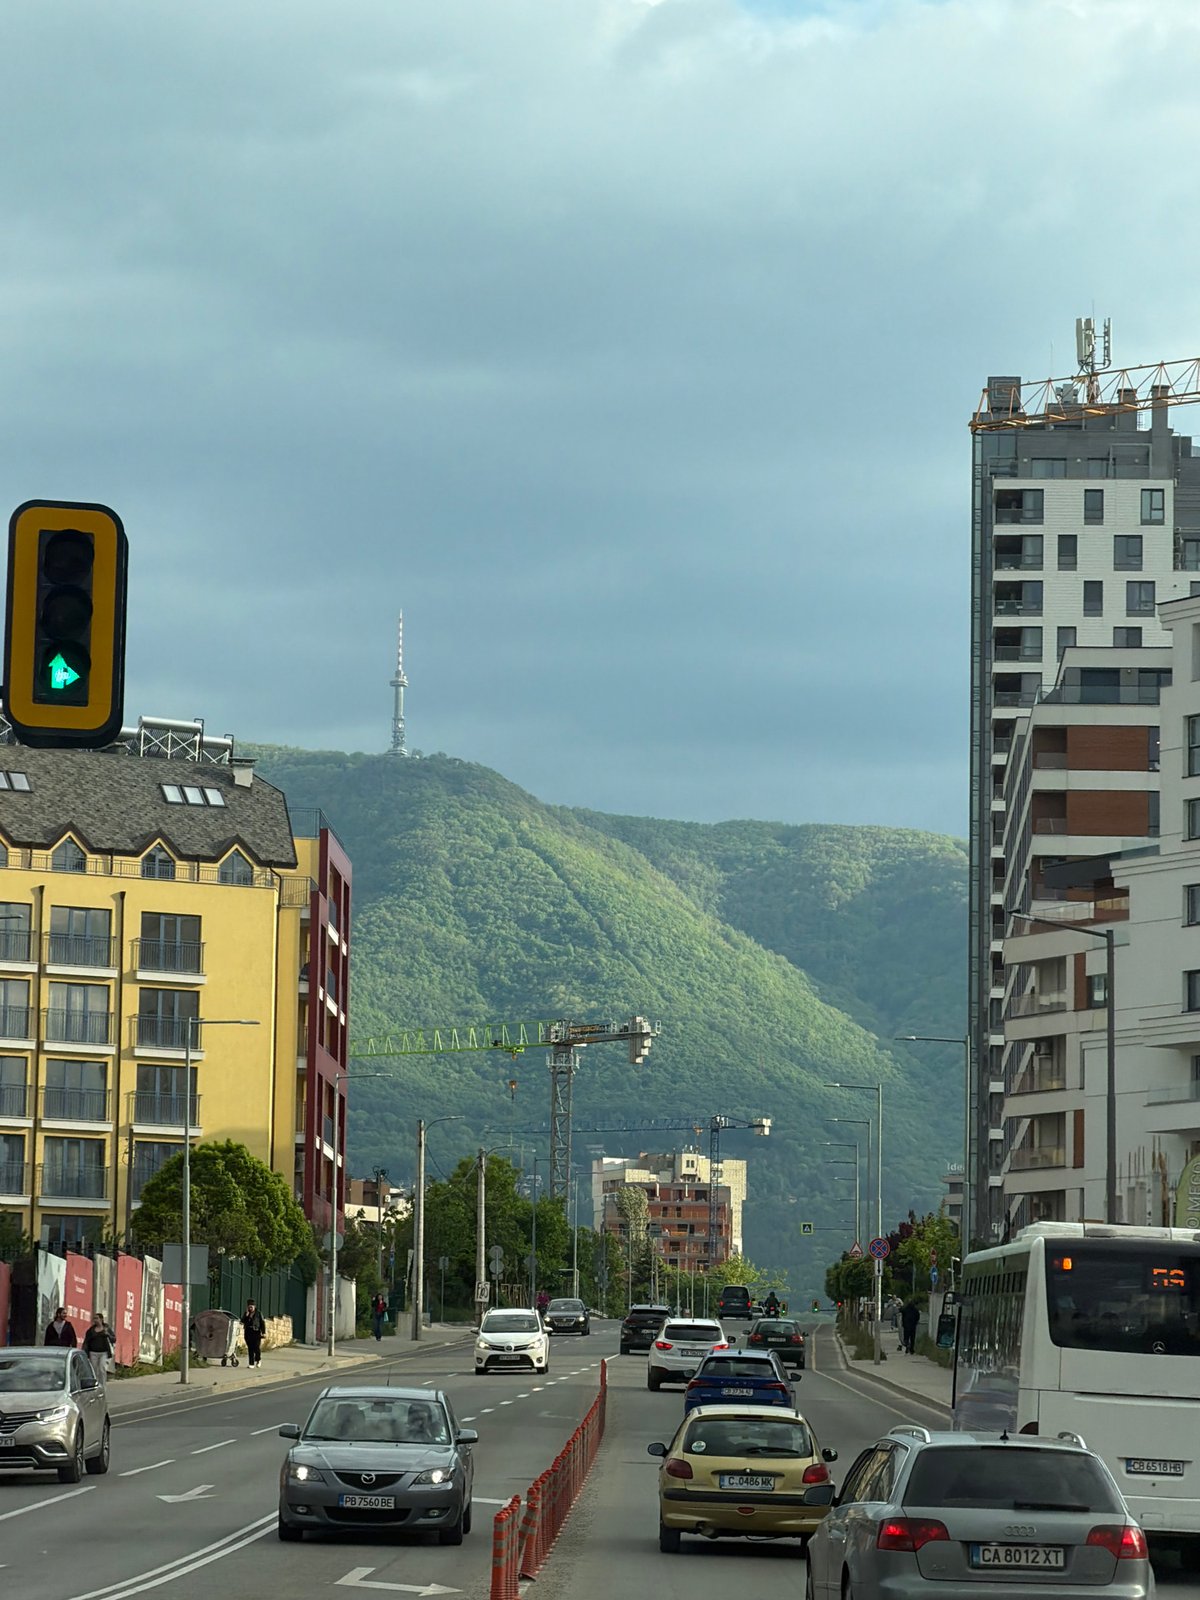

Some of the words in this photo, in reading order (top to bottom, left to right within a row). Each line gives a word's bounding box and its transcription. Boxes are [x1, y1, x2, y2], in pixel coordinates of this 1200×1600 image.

[1132, 1461, 1144, 1471] CB
[1146, 1462, 1168, 1472] 6518
[1169, 1463, 1182, 1472] HB
[345, 1496, 356, 1506] PB
[358, 1497, 380, 1507] 7560
[381, 1498, 392, 1508] BE
[982, 1548, 1001, 1563] CA
[1004, 1548, 1040, 1564] 8012
[1043, 1550, 1062, 1565] XT
